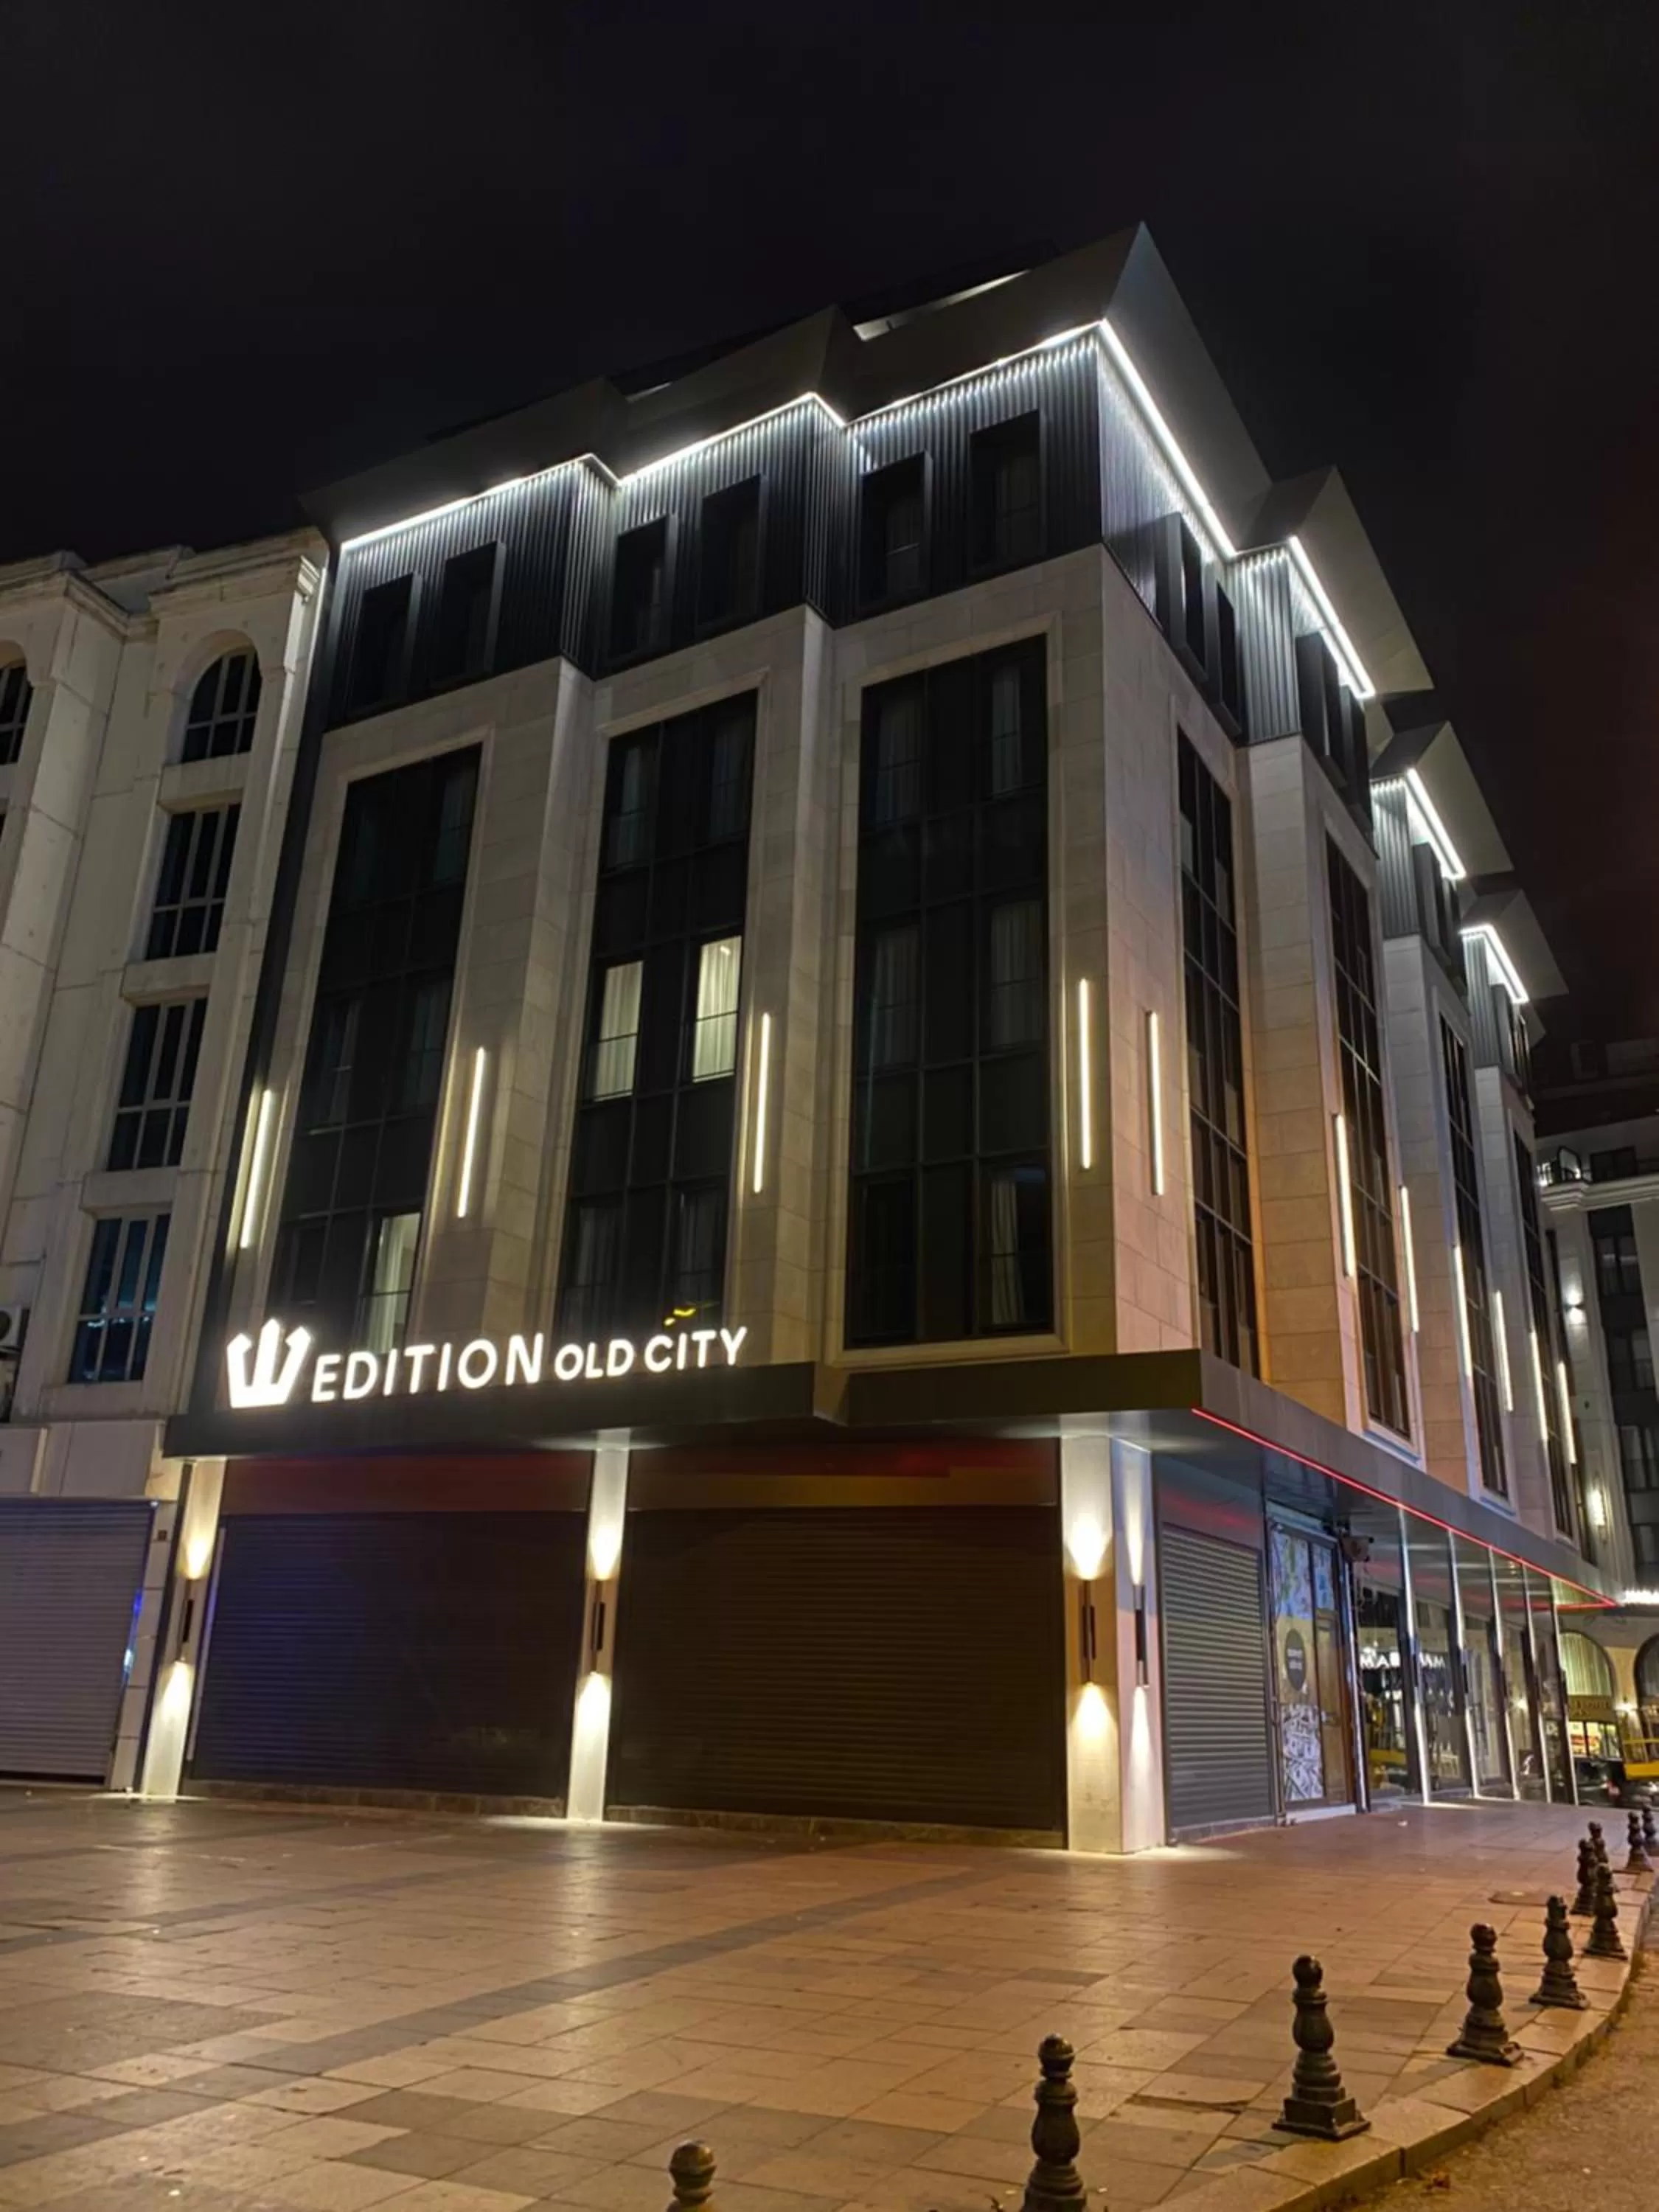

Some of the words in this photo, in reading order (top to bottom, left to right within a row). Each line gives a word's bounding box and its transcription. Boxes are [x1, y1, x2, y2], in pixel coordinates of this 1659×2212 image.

[310, 1332, 544, 1402] EDITION
[554, 1338, 636, 1381] OLD
[644, 1326, 748, 1372] CITY
